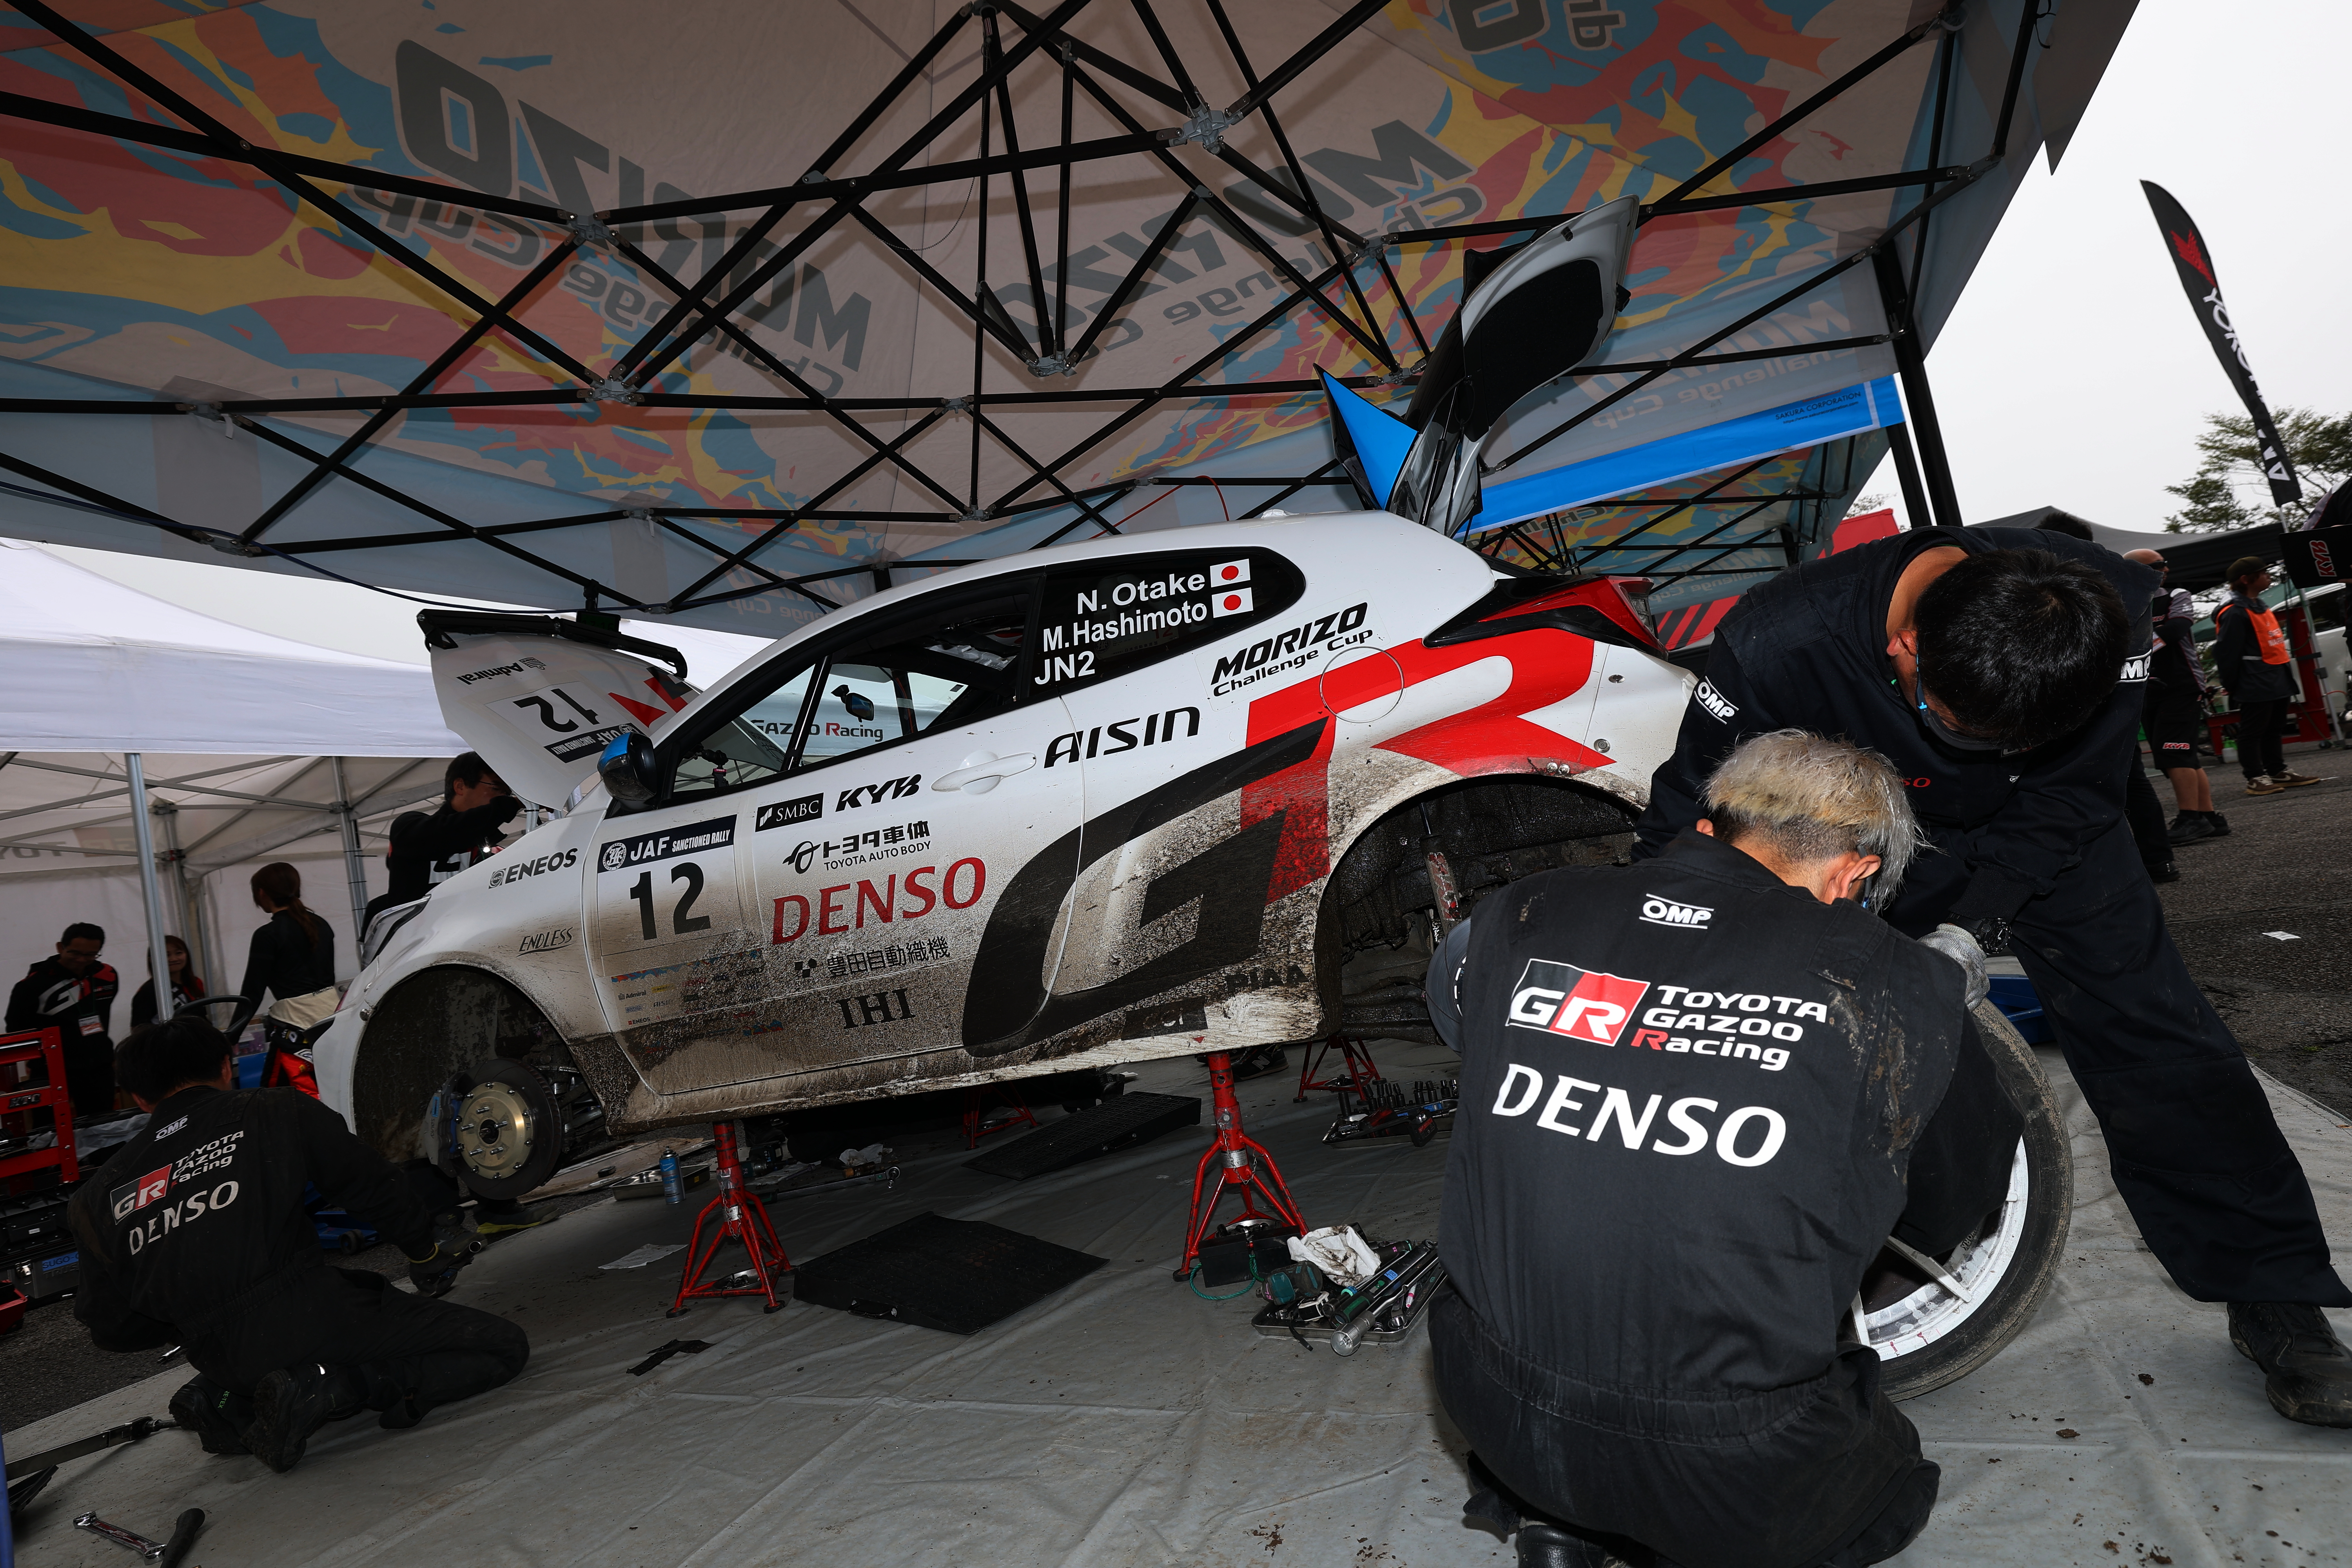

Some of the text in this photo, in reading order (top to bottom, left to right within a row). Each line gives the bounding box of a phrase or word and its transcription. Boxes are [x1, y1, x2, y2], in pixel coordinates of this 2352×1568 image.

[1775, 391, 1861, 420] SAKURA CORPORATION
[2310, 539, 2337, 577] KYB
[1112, 573, 1205, 606] Otake
[1210, 602, 1368, 686] MORIZO
[1213, 629, 1373, 697] Challenge Cup
[456, 662, 524, 685] Admiral
[1034, 650, 1096, 685] JN2
[2120, 655, 2151, 680] MP
[513, 688, 601, 733] 12
[1697, 680, 1735, 719] OMP
[751, 719, 883, 742] GAZO Racing
[1044, 706, 1200, 769] AISIN
[2162, 742, 2191, 750] KYB
[776, 800, 819, 822] SMBC
[835, 774, 922, 812] KYB
[630, 829, 730, 862] JAF SANCTIONED RALLY
[823, 820, 930, 858] トヨタ車体
[824, 840, 931, 871] TOYOTA AUTO BODY
[505, 848, 578, 884] ENEOS
[630, 862, 711, 941] 12
[773, 857, 987, 945] DENSO
[1642, 899, 1712, 924] OMP
[518, 926, 573, 953] ENDLESS
[827, 936, 951, 978] 豊田自動織機
[626, 990, 646, 999] Admiral
[835, 987, 916, 1029] IHI
[1510, 986, 1627, 1041] GR
[1657, 985, 1828, 1024] TOYOTA
[1642, 1007, 1804, 1042] GAZOO
[1630, 1027, 1791, 1071] Racing
[157, 1117, 189, 1140] OMP
[1492, 1063, 1787, 1168] DENSO
[115, 1179, 166, 1220] GR
[129, 1180, 239, 1255] DENSO
